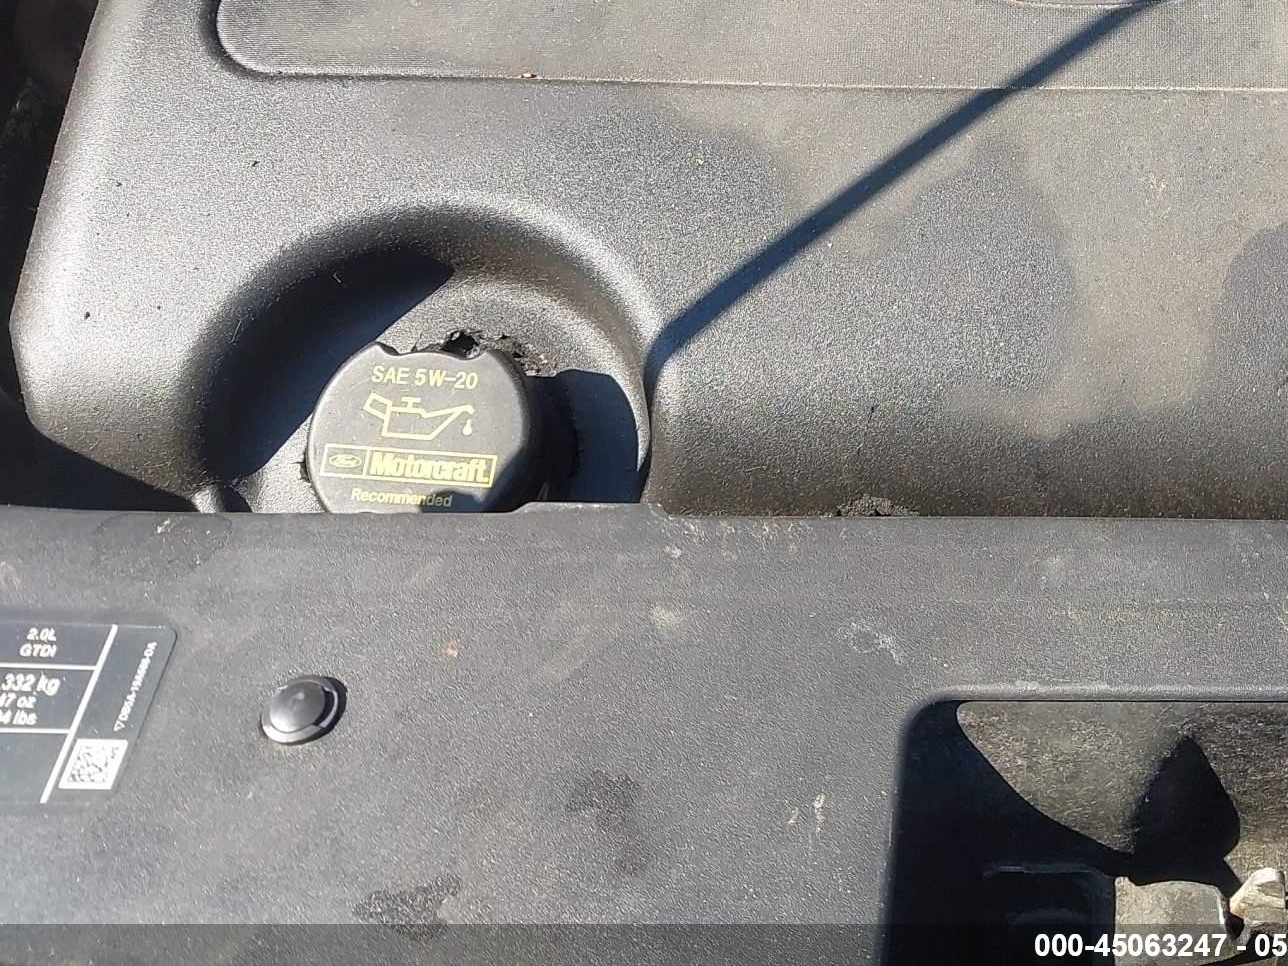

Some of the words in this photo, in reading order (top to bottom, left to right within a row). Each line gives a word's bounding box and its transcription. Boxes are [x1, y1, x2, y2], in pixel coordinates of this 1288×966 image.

[371, 366, 410, 385] SAE
[414, 370, 479, 390] 5W-20
[370, 451, 487, 483] Motorcraft
[351, 488, 453, 507] Recommended
[27, 627, 57, 642] 2.0L
[37, 674, 61, 696] kg
[17, 696, 37, 709] oz
[13, 709, 38, 725] lbs
